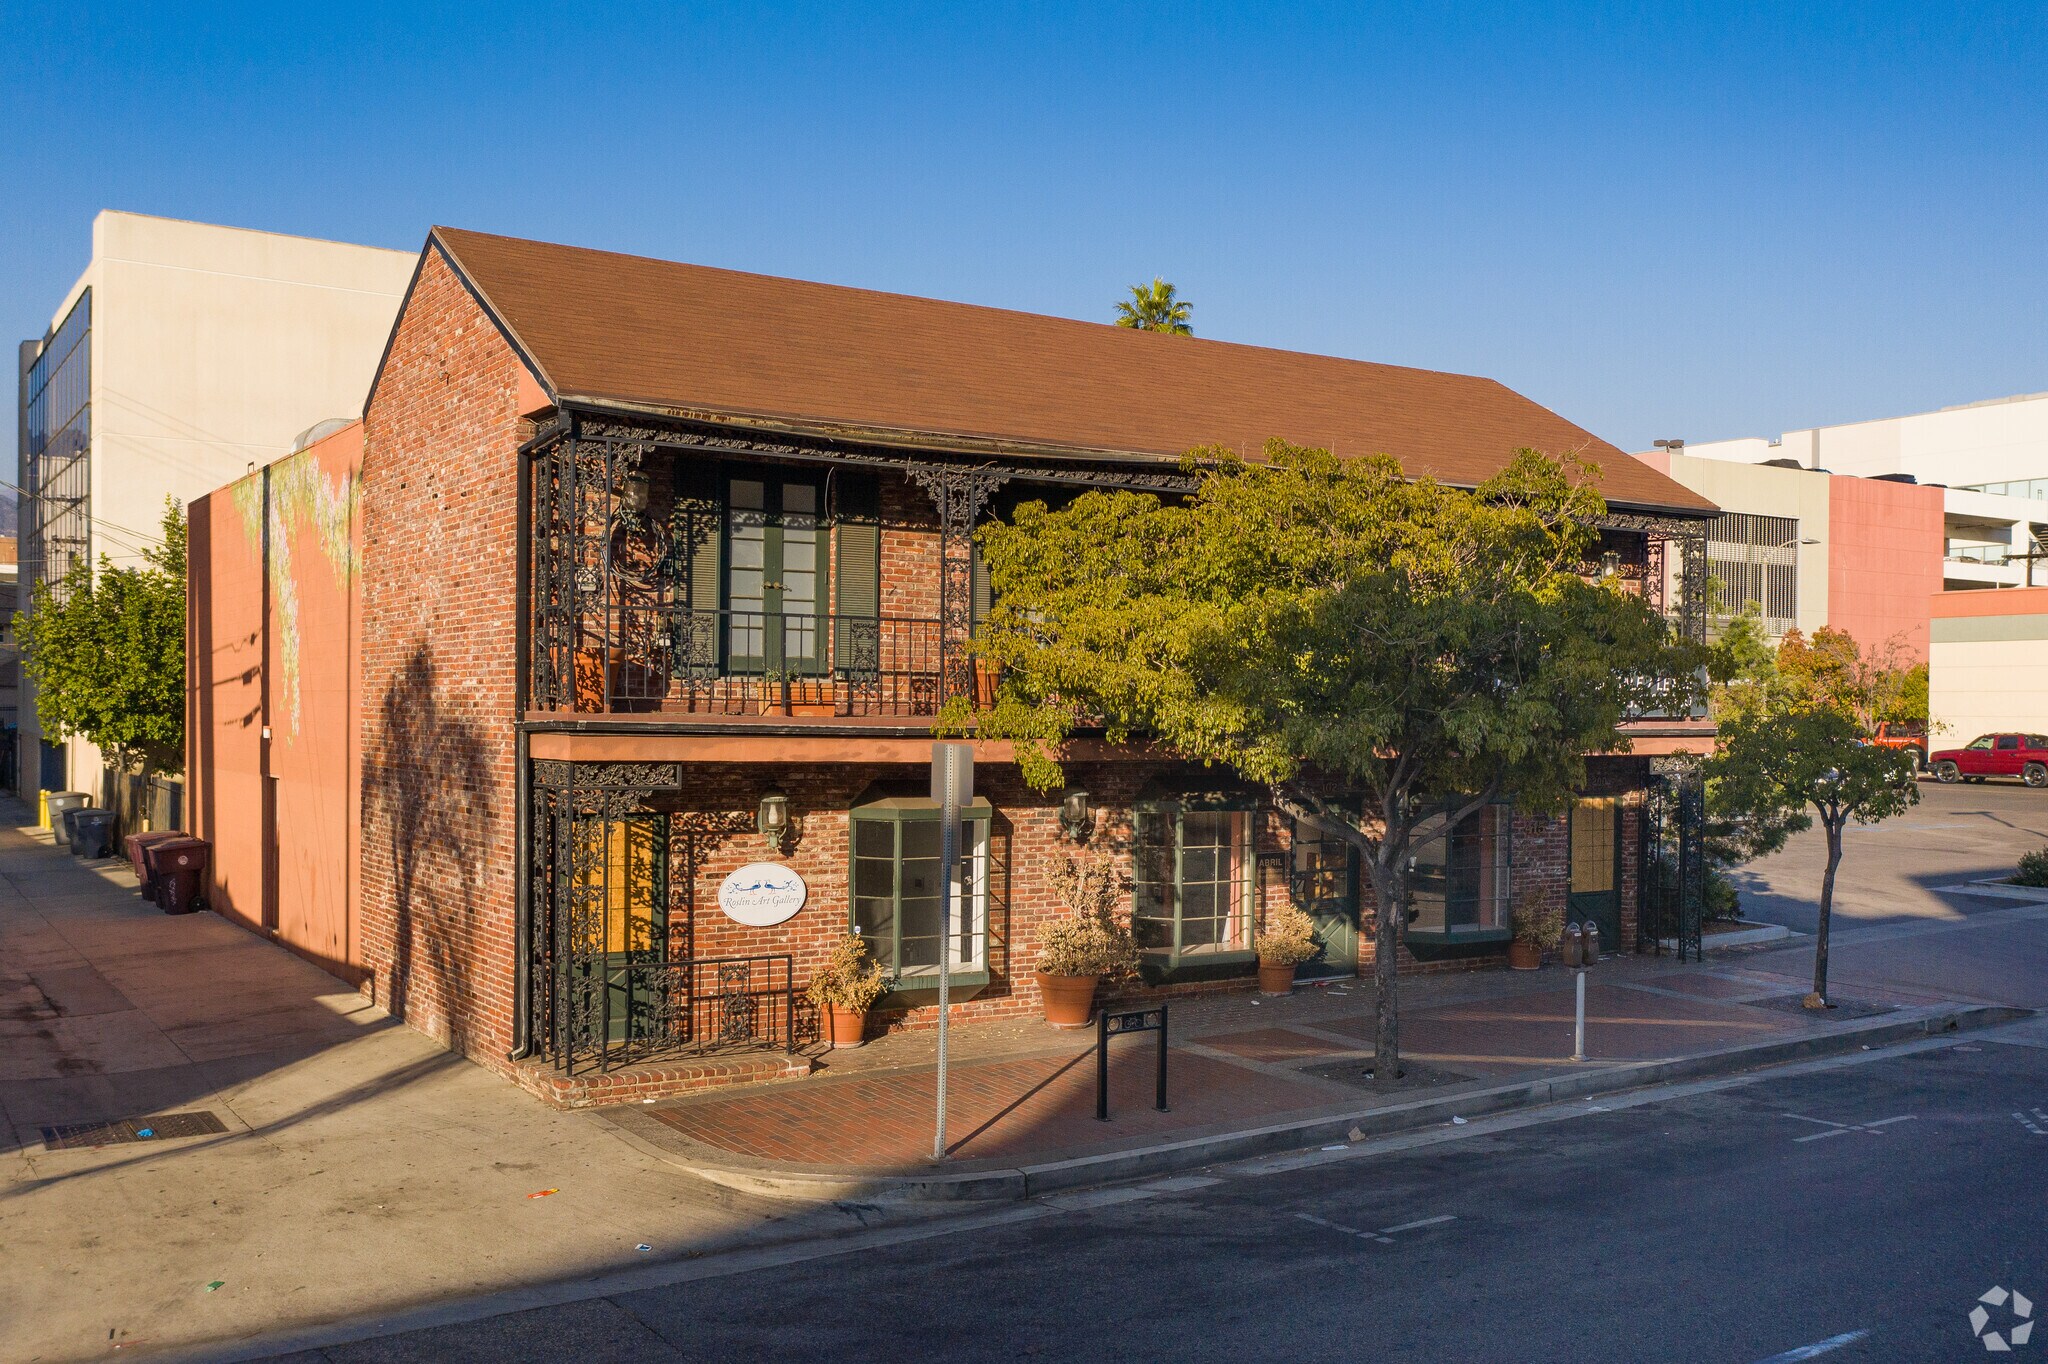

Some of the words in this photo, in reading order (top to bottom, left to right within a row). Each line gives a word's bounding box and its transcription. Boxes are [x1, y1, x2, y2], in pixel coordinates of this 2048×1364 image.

[1259, 858, 1283, 867] ABRIL
[723, 895, 750, 909] Roslin
[752, 896, 771, 906] Art
[772, 895, 801, 908] Gallery
